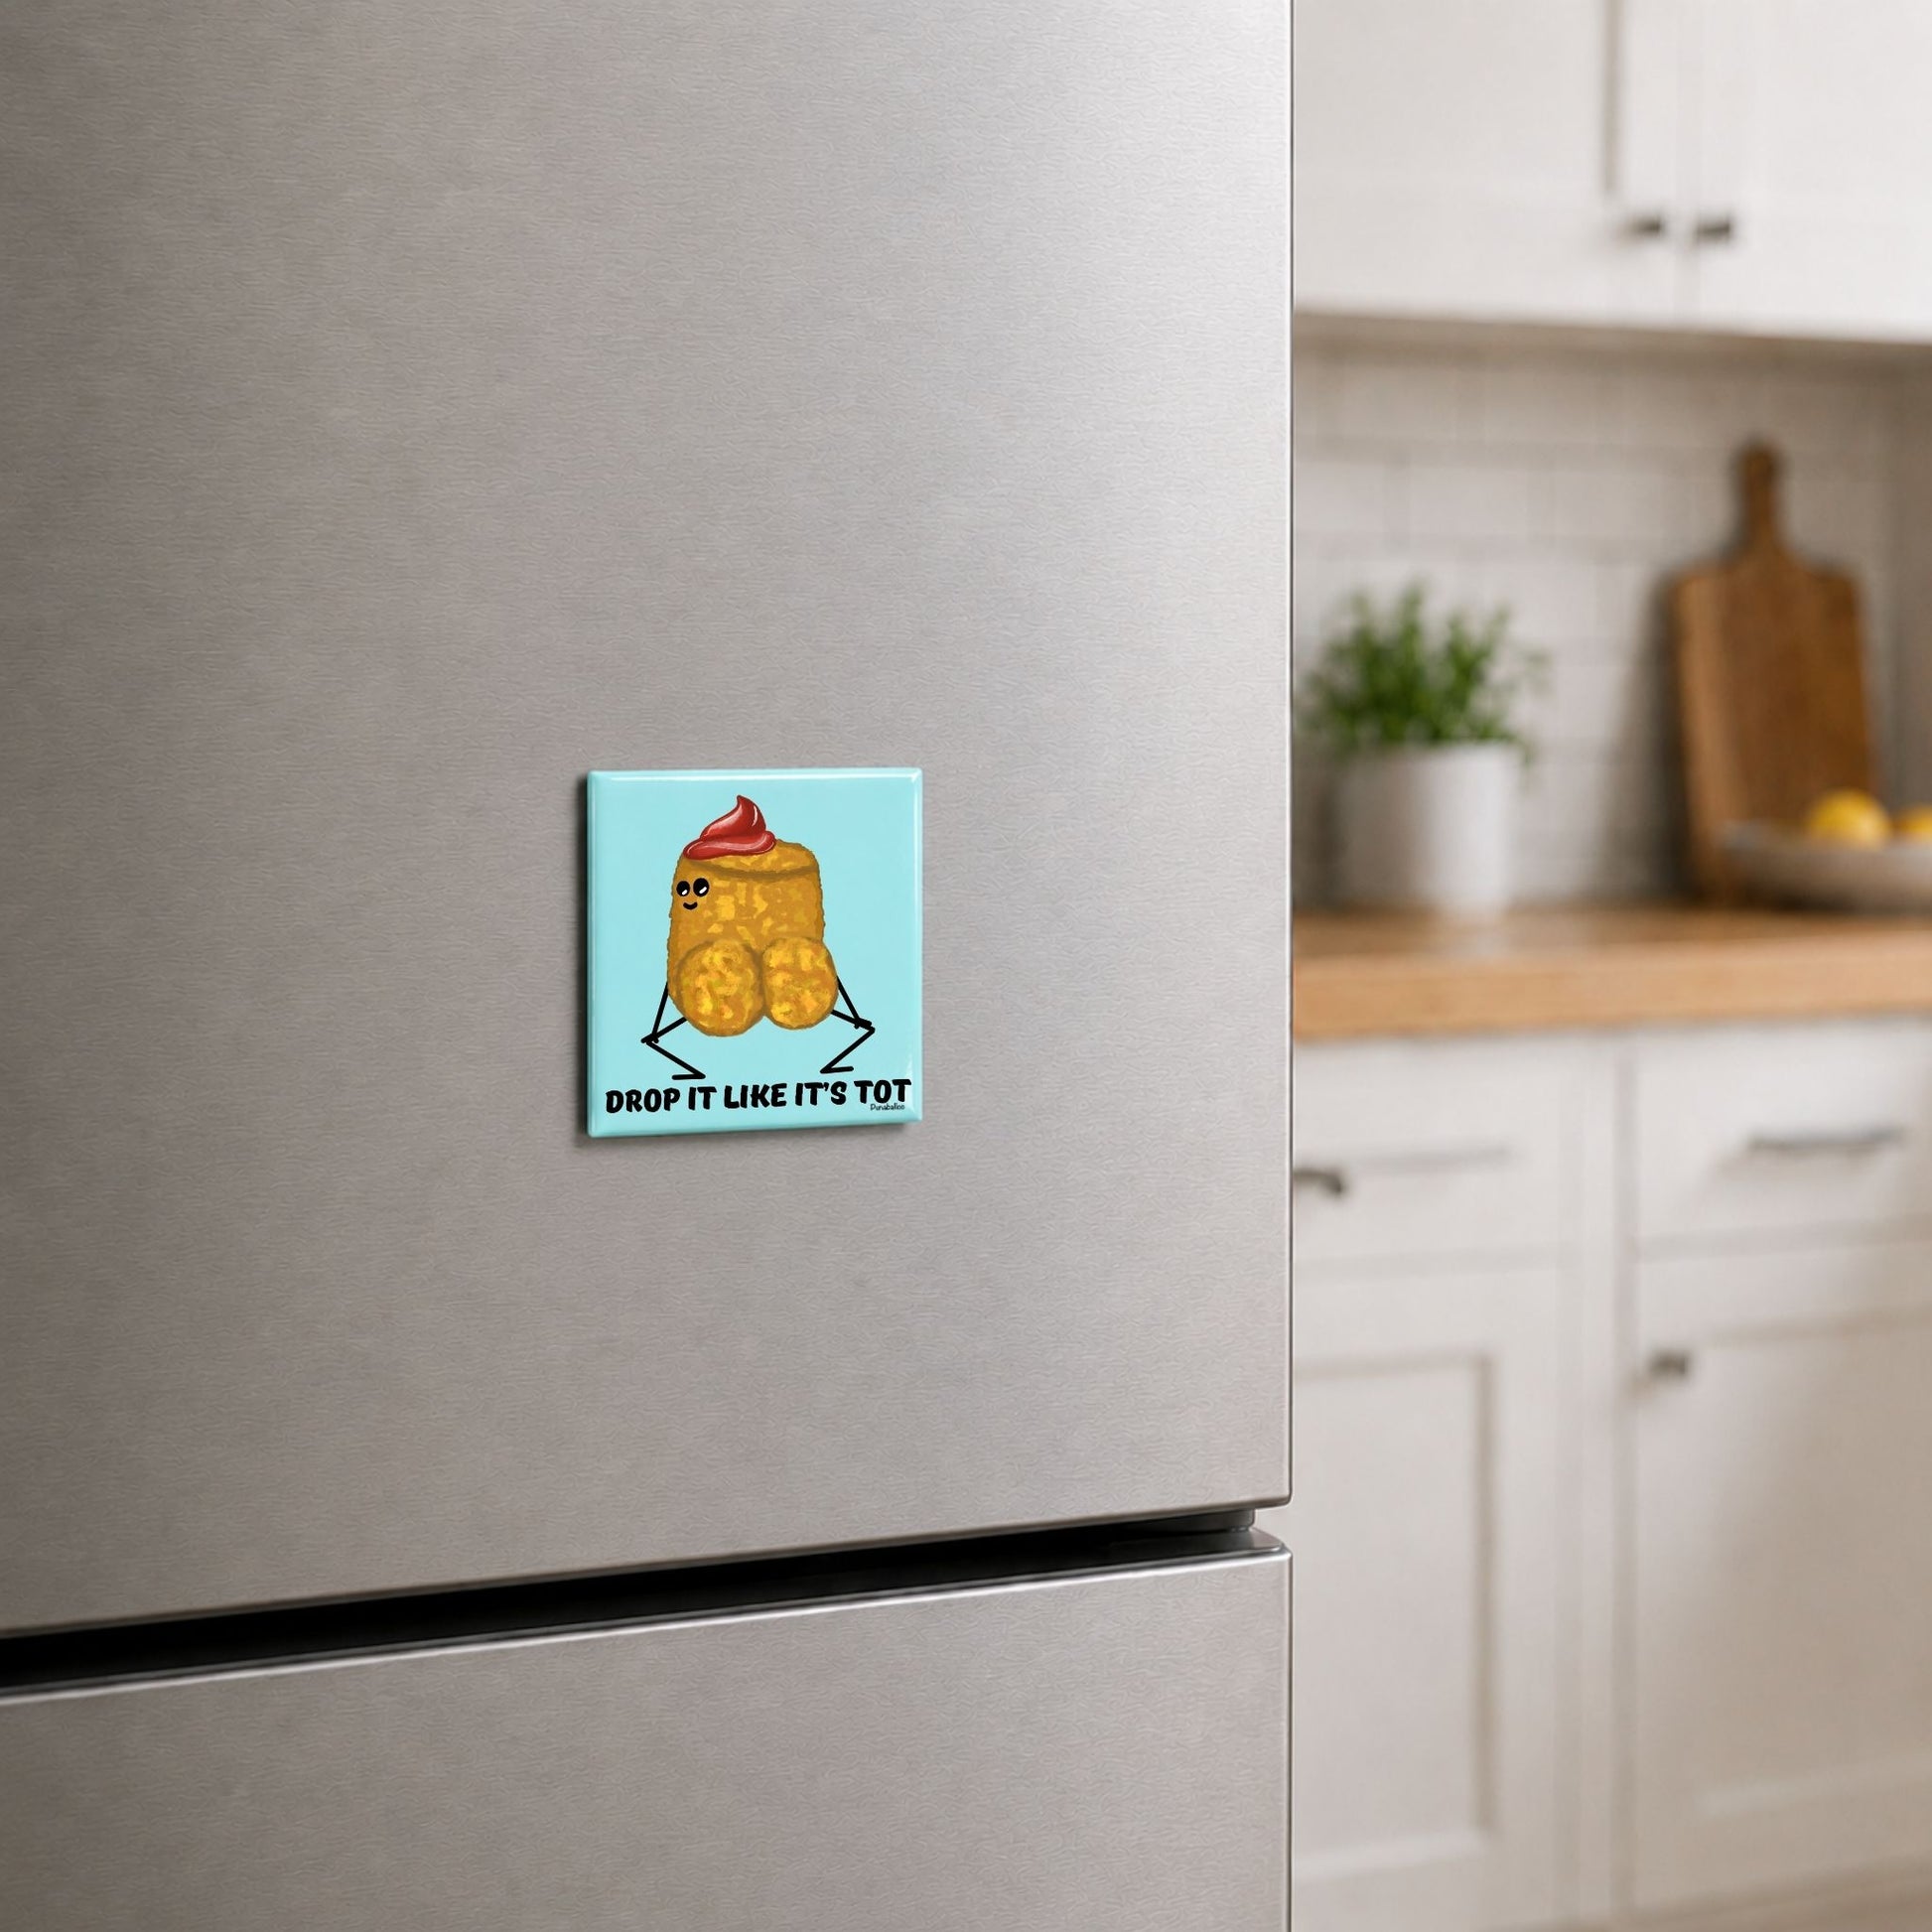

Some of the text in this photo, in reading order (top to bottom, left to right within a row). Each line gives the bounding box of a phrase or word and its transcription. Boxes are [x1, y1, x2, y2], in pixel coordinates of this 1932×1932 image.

[605, 1079, 911, 1114] DROP IT LIKE IT'S TOT
